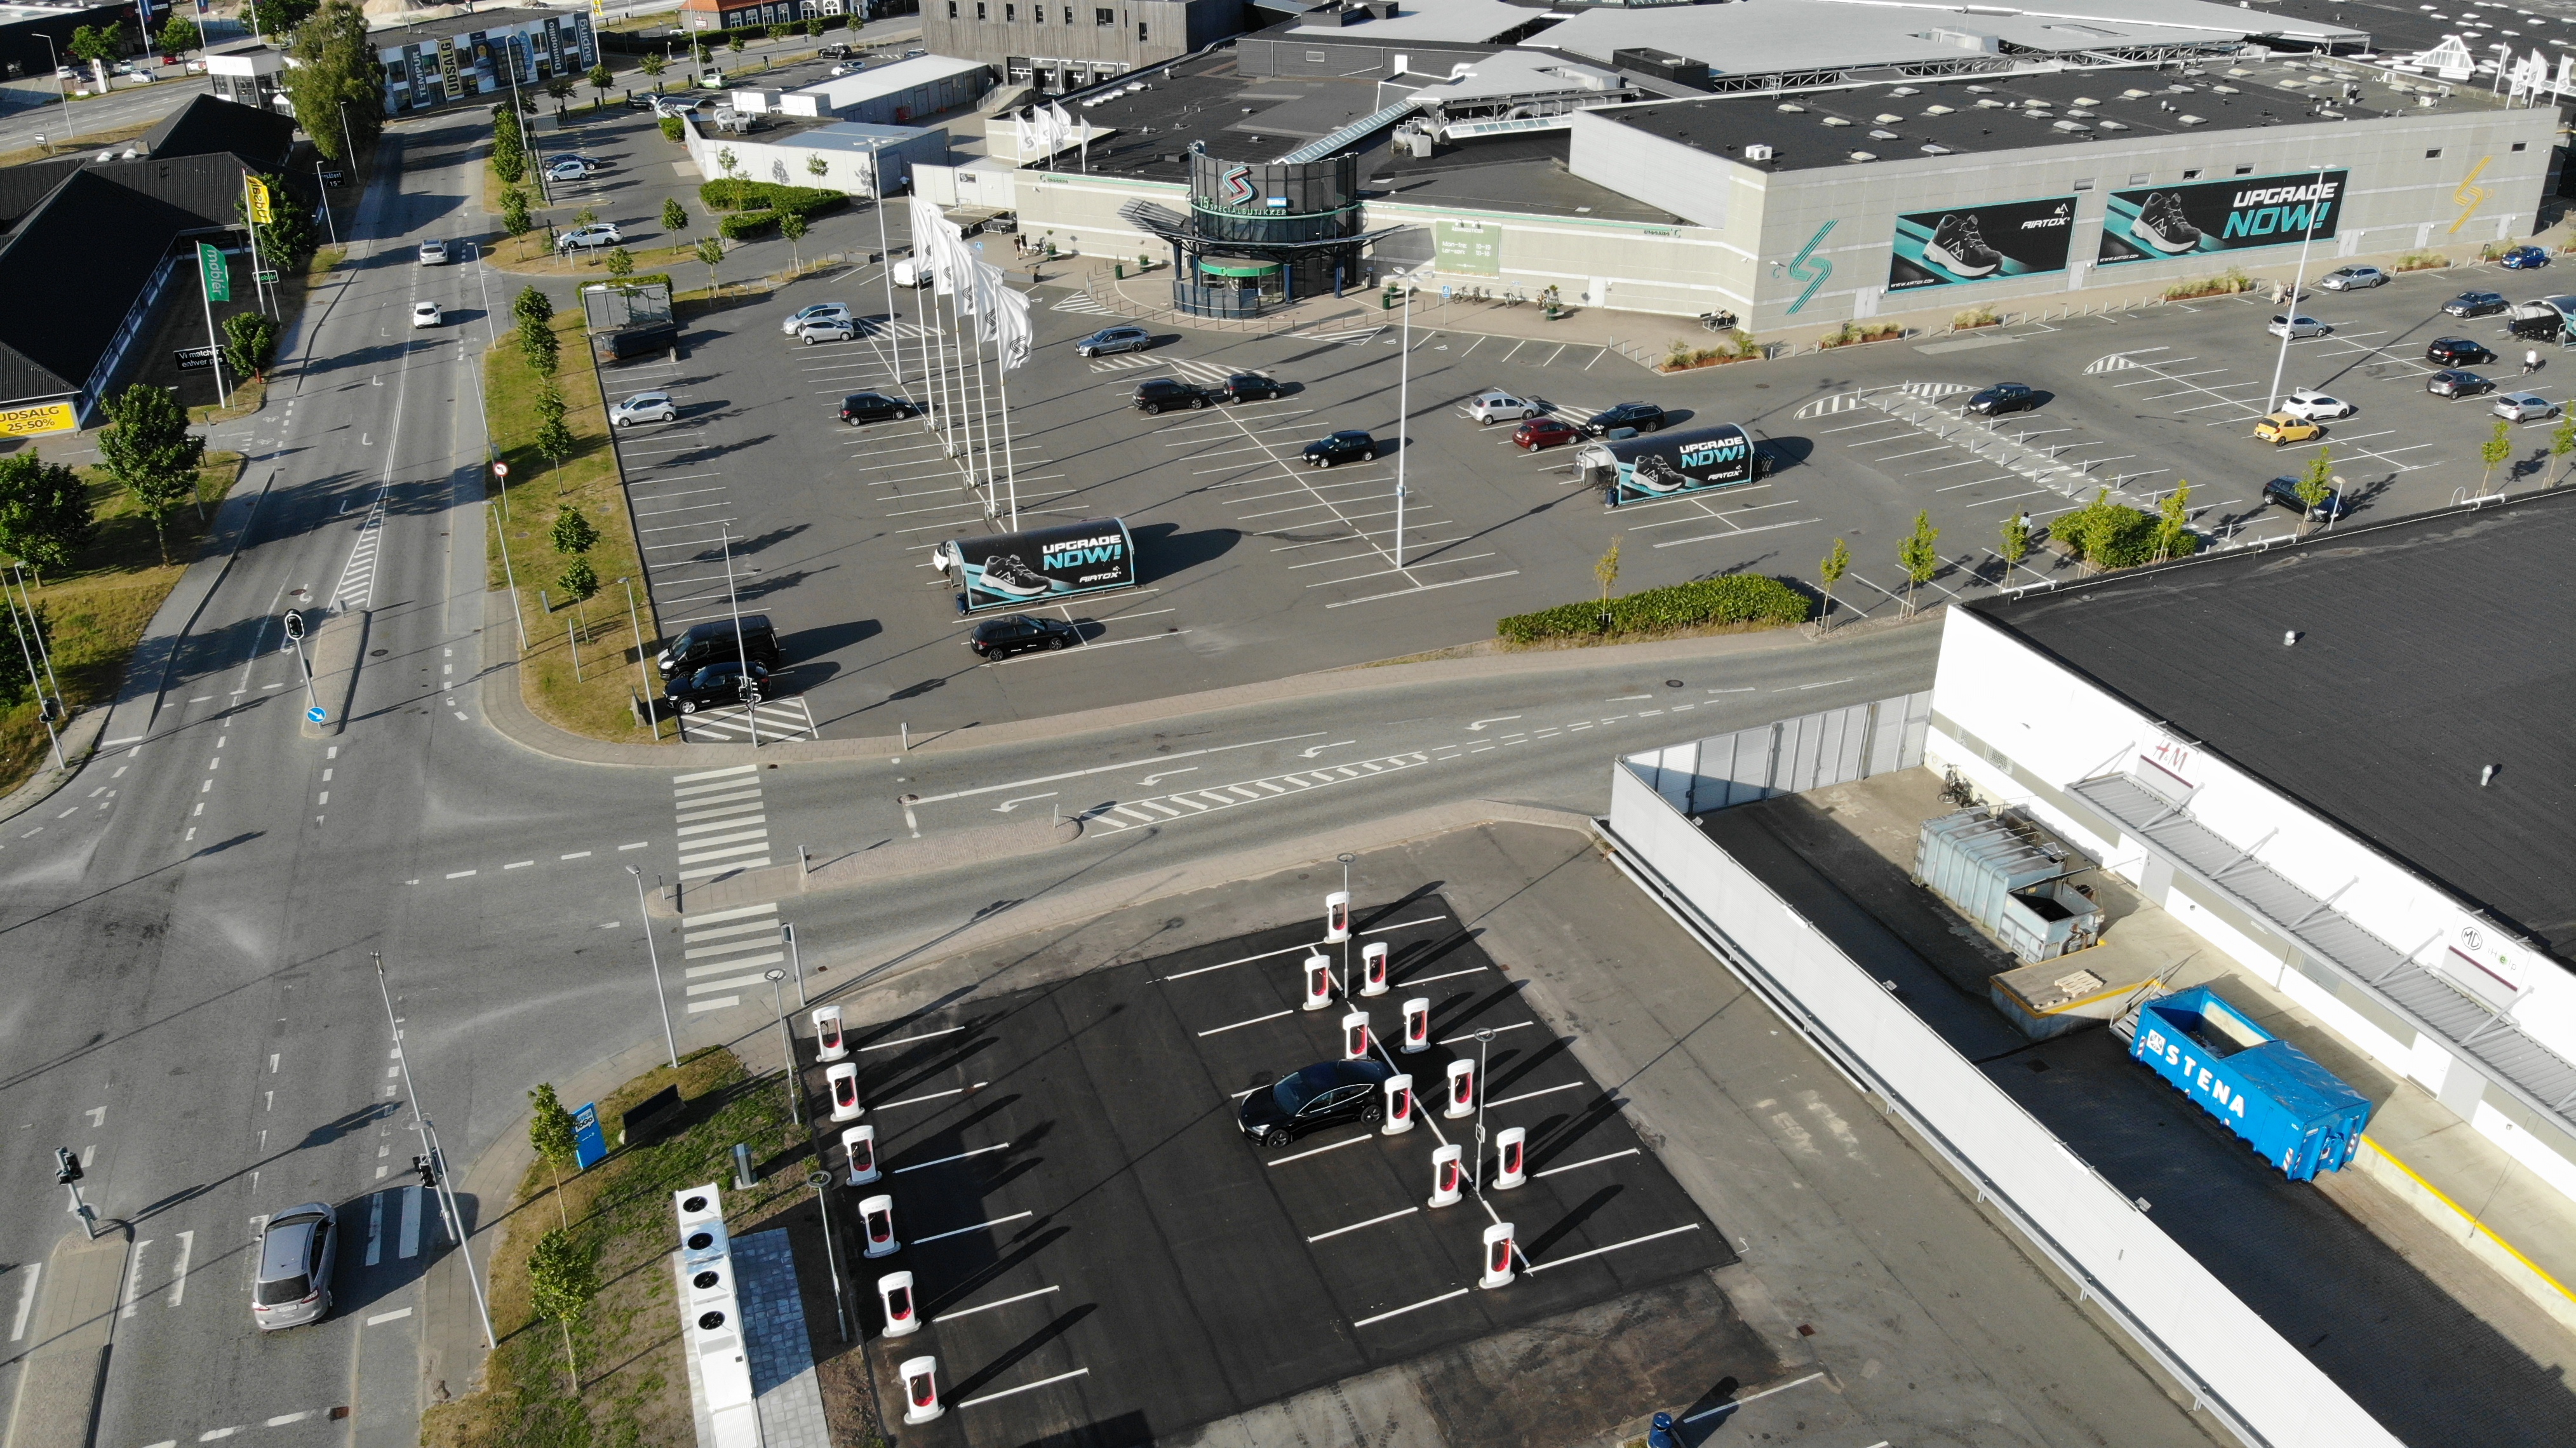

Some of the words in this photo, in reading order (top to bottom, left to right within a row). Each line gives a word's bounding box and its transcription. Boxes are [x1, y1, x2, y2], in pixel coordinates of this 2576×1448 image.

[548, 22, 561, 70] Dunlopillo
[580, 18, 593, 62] auping
[413, 50, 427, 97] TEMPUR
[441, 42, 460, 92] UDSALG
[2233, 182, 2338, 208] UPGRADE
[1210, 204, 1287, 216] SPECIALBUTIKKER
[2222, 202, 2331, 239] NOW!
[189, 349, 220, 358] matchr
[6, 418, 55, 432] 25-50%
[1679, 436, 1744, 453] UPGRADE
[1681, 445, 1745, 469] NOW!
[1042, 534, 1122, 554] UPGRADE
[1043, 544, 1122, 571] NOW!
[2152, 739, 2189, 773] H&M
[2164, 1043, 2245, 1118] STENA
